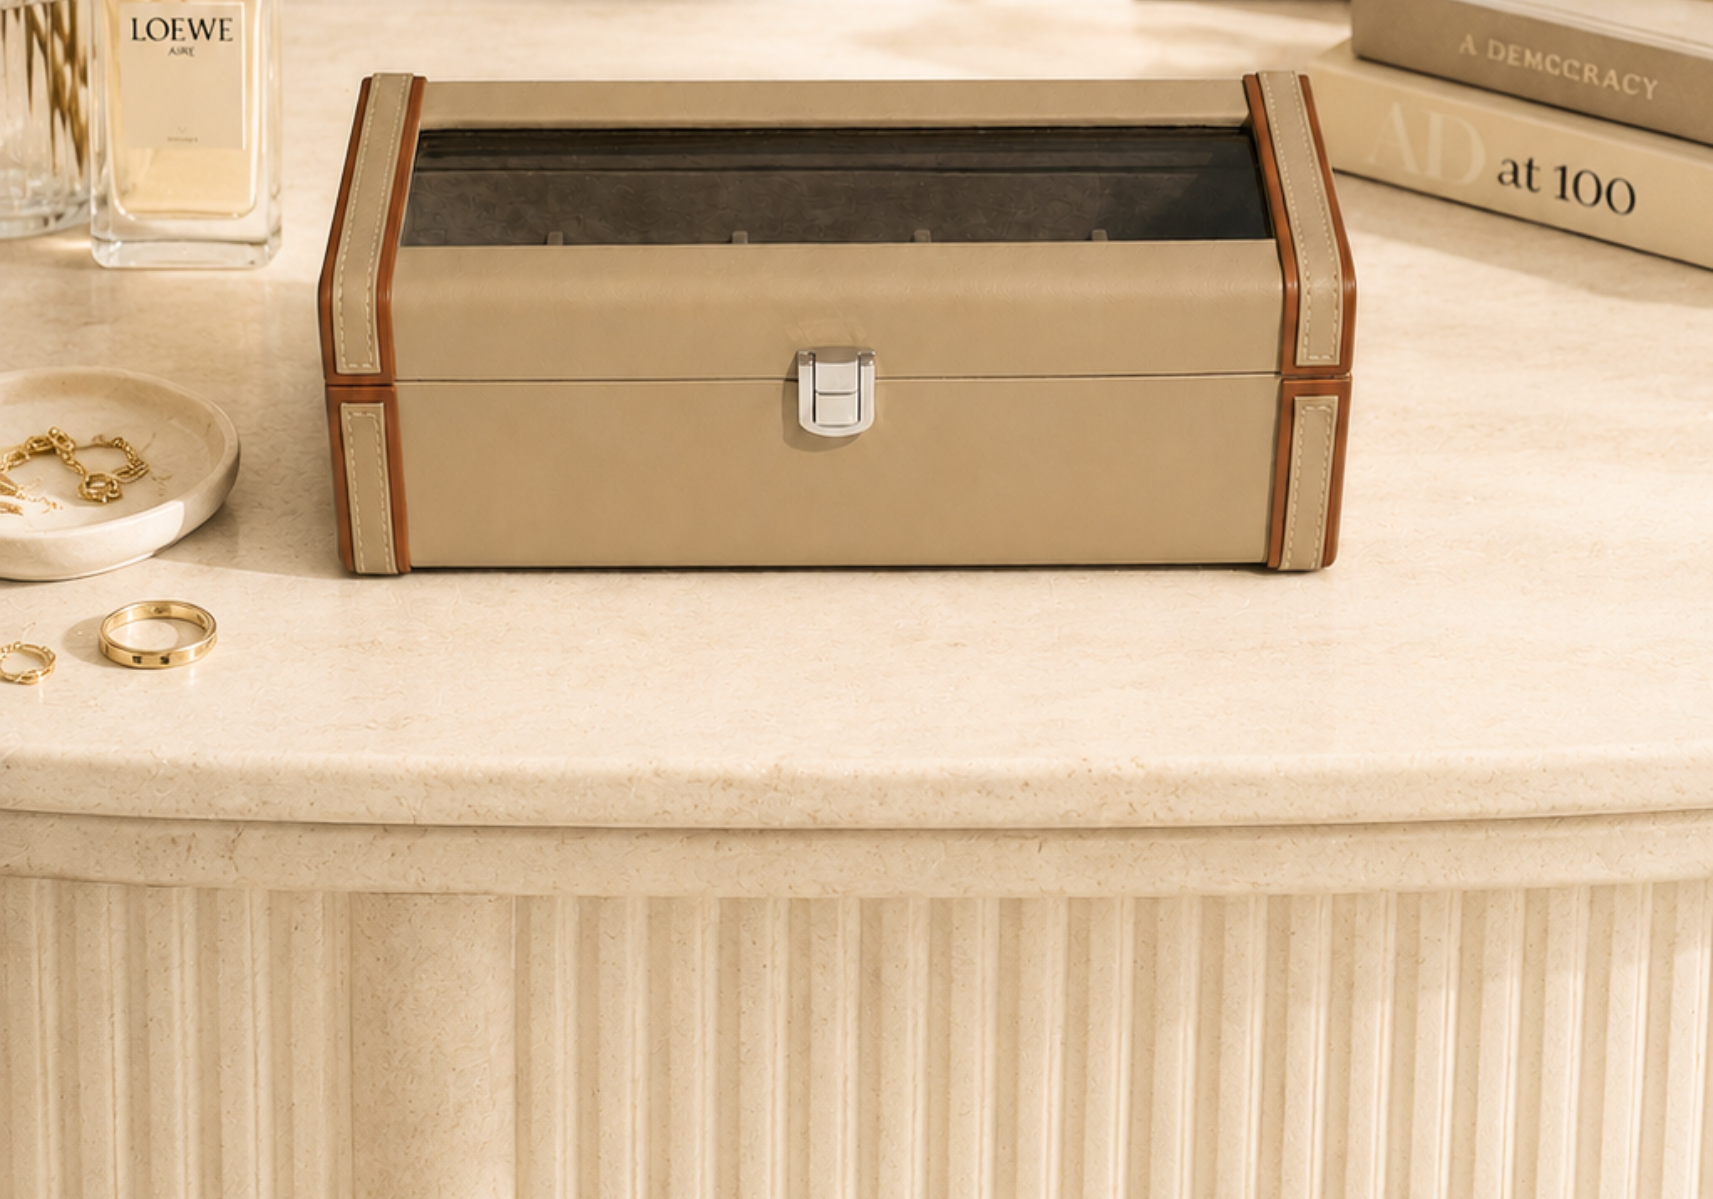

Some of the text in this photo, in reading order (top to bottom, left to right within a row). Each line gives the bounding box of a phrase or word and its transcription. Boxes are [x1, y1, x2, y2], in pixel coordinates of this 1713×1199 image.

[131, 17, 233, 42] LOEWE
[1459, 34, 1477, 56] A
[1365, 102, 1636, 216] AD at 100
